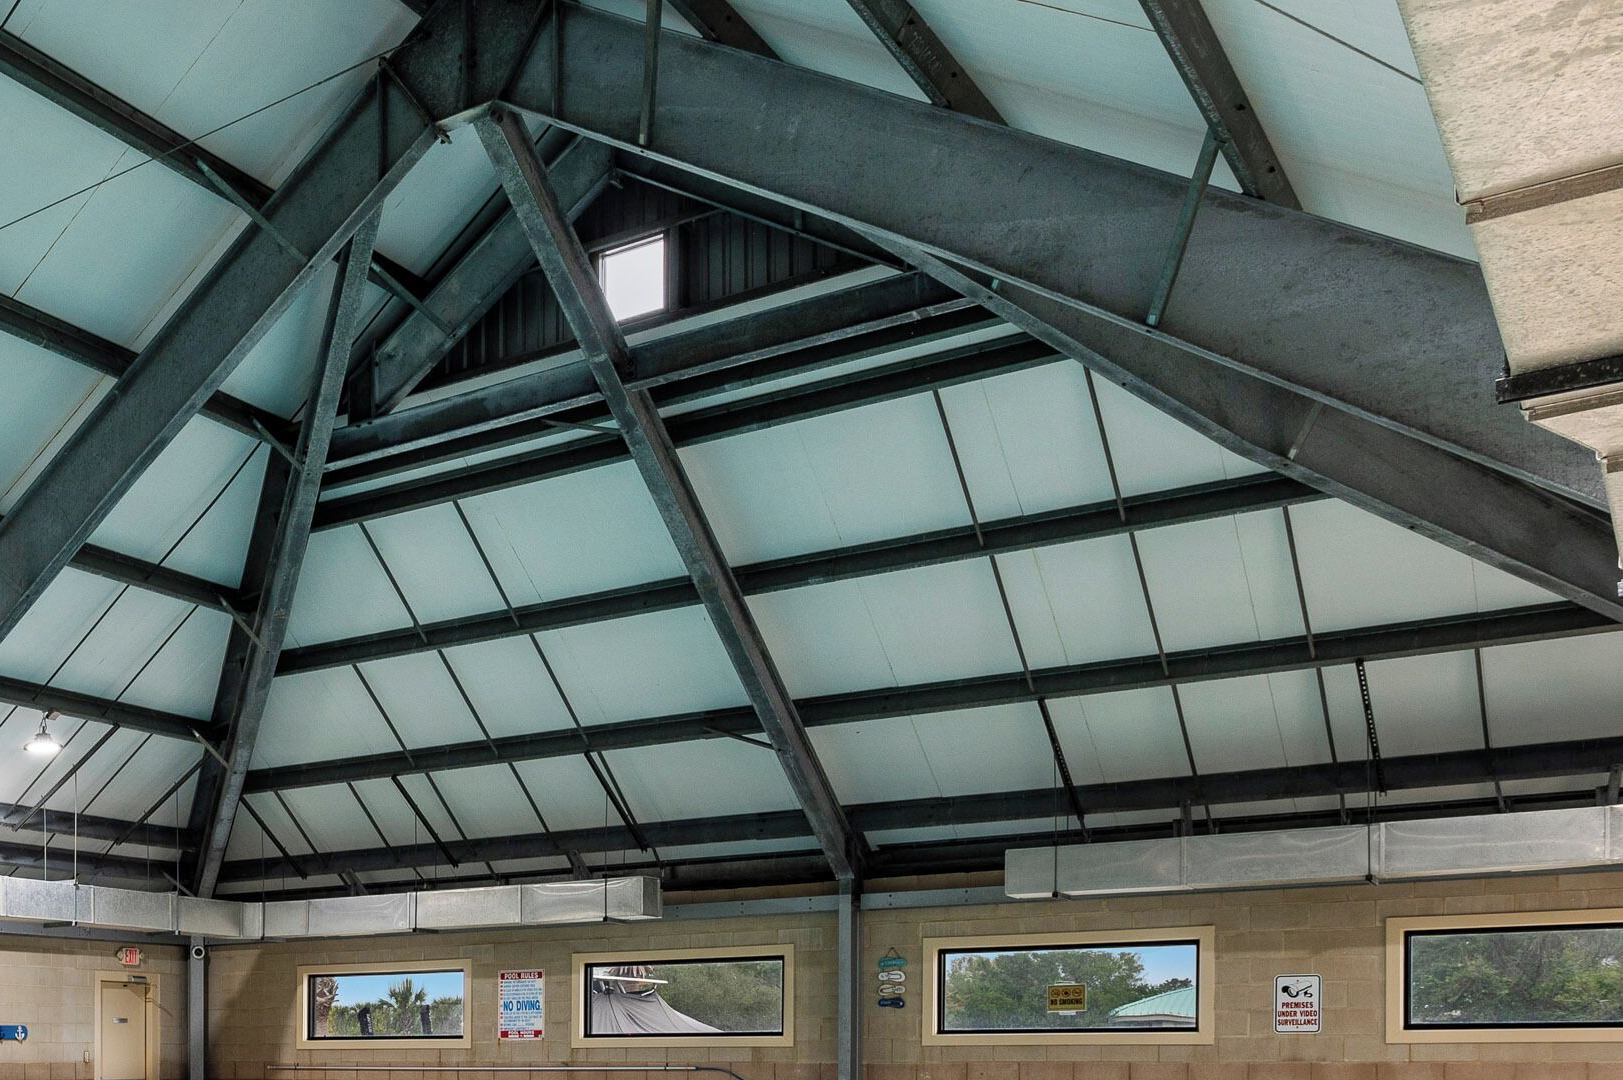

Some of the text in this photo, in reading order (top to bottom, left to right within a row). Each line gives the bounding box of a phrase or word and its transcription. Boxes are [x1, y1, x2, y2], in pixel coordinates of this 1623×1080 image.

[504, 1000, 514, 1011] NO
[1050, 998, 1058, 1006] NO
[1277, 1018, 1318, 1026] SURVEILLANCE
